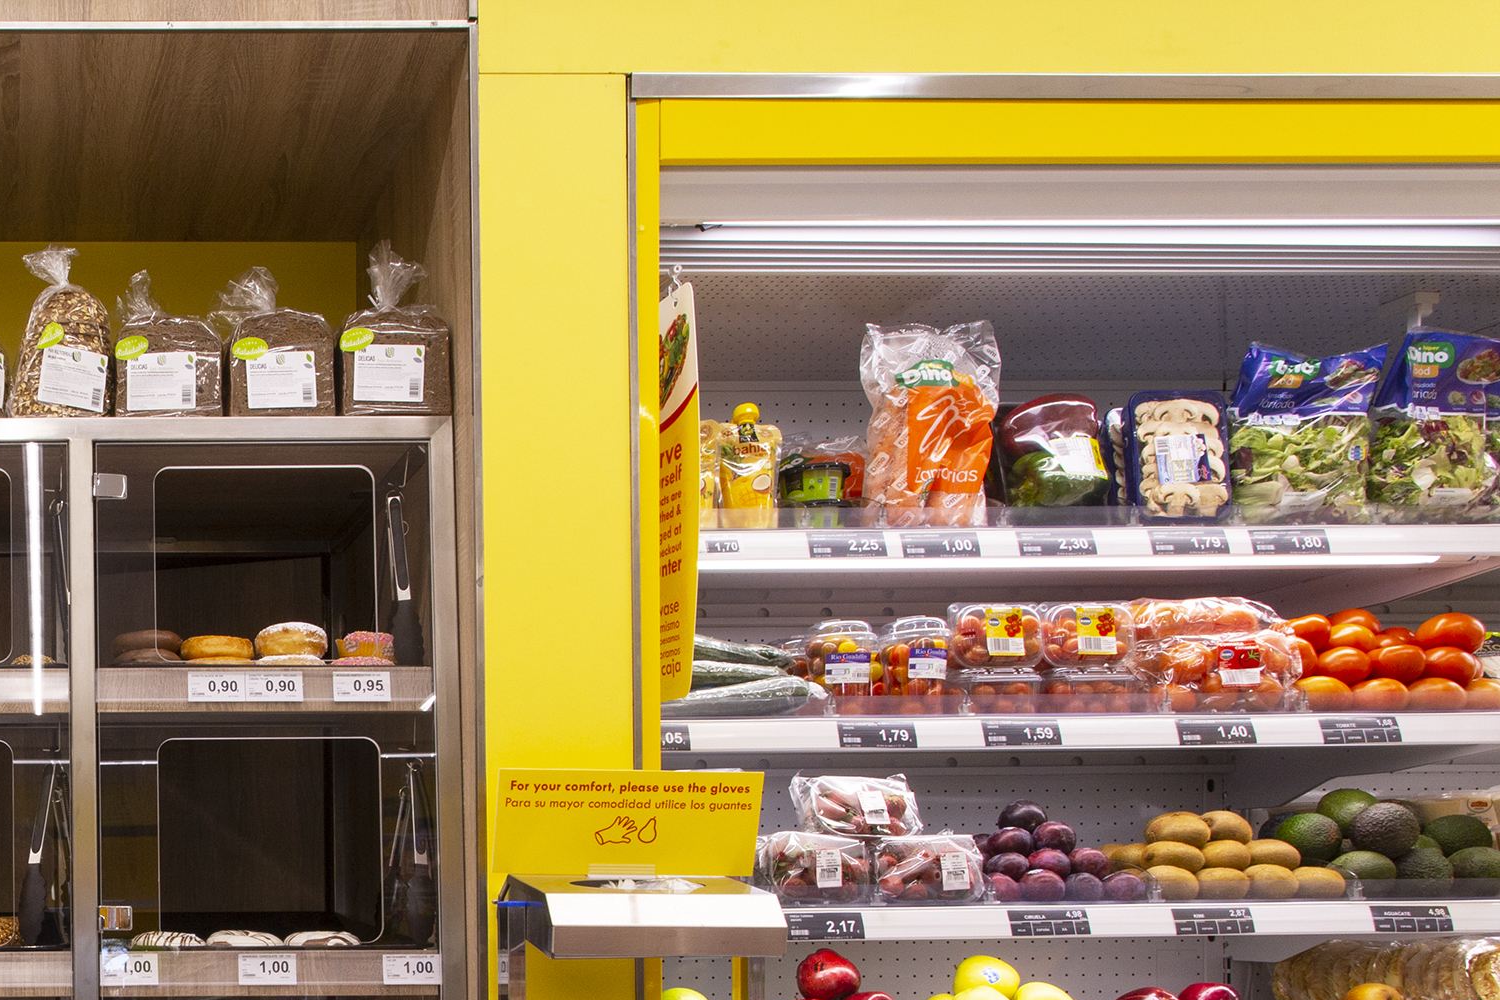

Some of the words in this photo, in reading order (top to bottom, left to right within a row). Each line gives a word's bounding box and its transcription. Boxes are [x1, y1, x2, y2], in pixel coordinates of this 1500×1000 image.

[1408, 346, 1449, 363] Dino
[902, 365, 953, 384] Dino
[660, 443, 682, 469] rve
[671, 489, 682, 501] are
[674, 523, 682, 535] at
[661, 659, 681, 678] caja
[662, 732, 683, 746] ,05
[510, 780, 530, 791] For
[533, 783, 561, 793] your
[565, 781, 616, 793] comfort,
[619, 782, 659, 795] please
[663, 785, 684, 793] use
[687, 782, 707, 793] the
[710, 783, 751, 796] gloves
[505, 797, 531, 808] Para
[535, 800, 546, 808] su
[549, 800, 585, 811] mayor
[588, 799, 651, 809] comodidad
[655, 799, 686, 810] utilice
[690, 800, 706, 810] los
[709, 802, 752, 813] guantes
[1065, 910, 1082, 918] 4,98
[1229, 910, 1245, 918] 2,87
